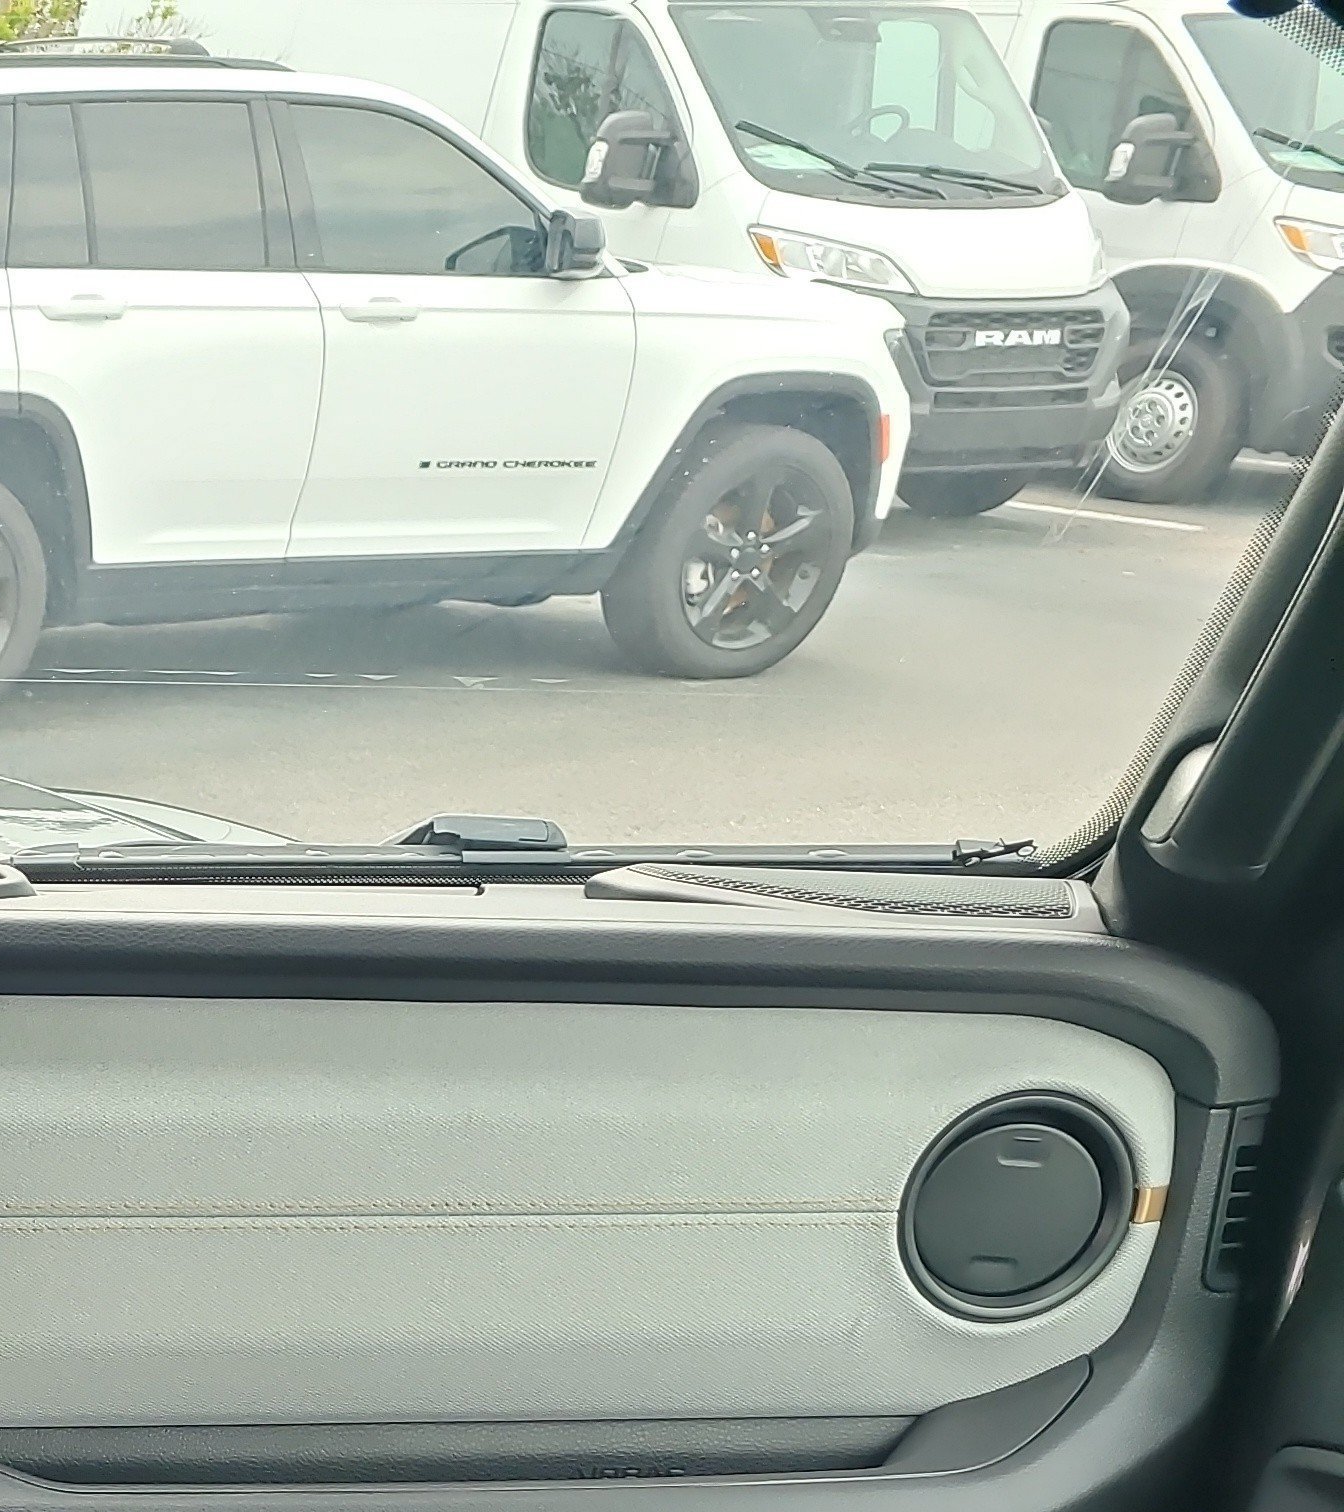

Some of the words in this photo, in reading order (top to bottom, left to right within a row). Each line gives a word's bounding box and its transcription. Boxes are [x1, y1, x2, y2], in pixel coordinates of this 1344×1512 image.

[975, 329, 1062, 347] RAM
[436, 460, 497, 469] GRAND
[503, 460, 597, 469] CHEROKEE
